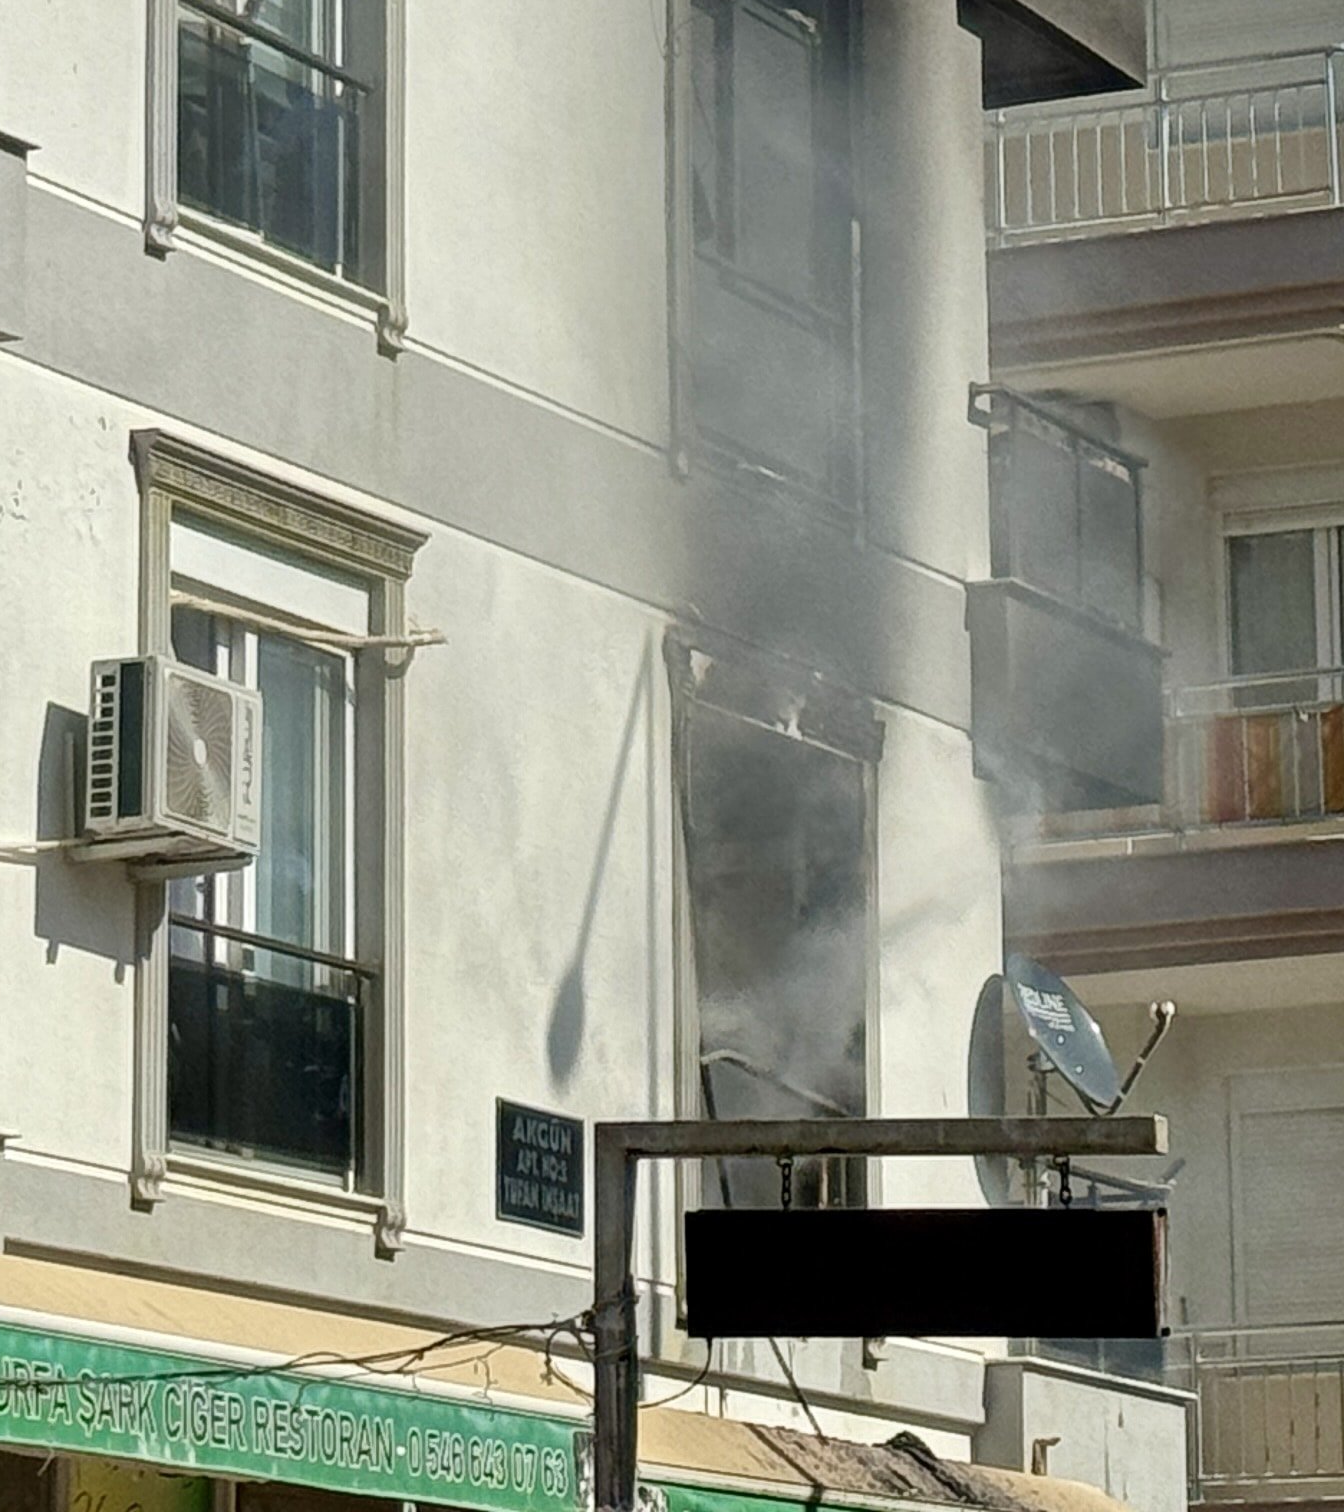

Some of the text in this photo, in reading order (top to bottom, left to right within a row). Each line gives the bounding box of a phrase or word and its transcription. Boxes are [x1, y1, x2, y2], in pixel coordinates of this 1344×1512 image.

[512, 1116, 572, 1155] AKGÜN
[76, 1368, 156, 1437] ŞARK
[252, 1396, 394, 1474] RESTORAN
[425, 1430, 464, 1483] 546
[469, 1436, 506, 1489] 643
[511, 1443, 541, 1493] 07
[542, 1447, 569, 1498] 63
